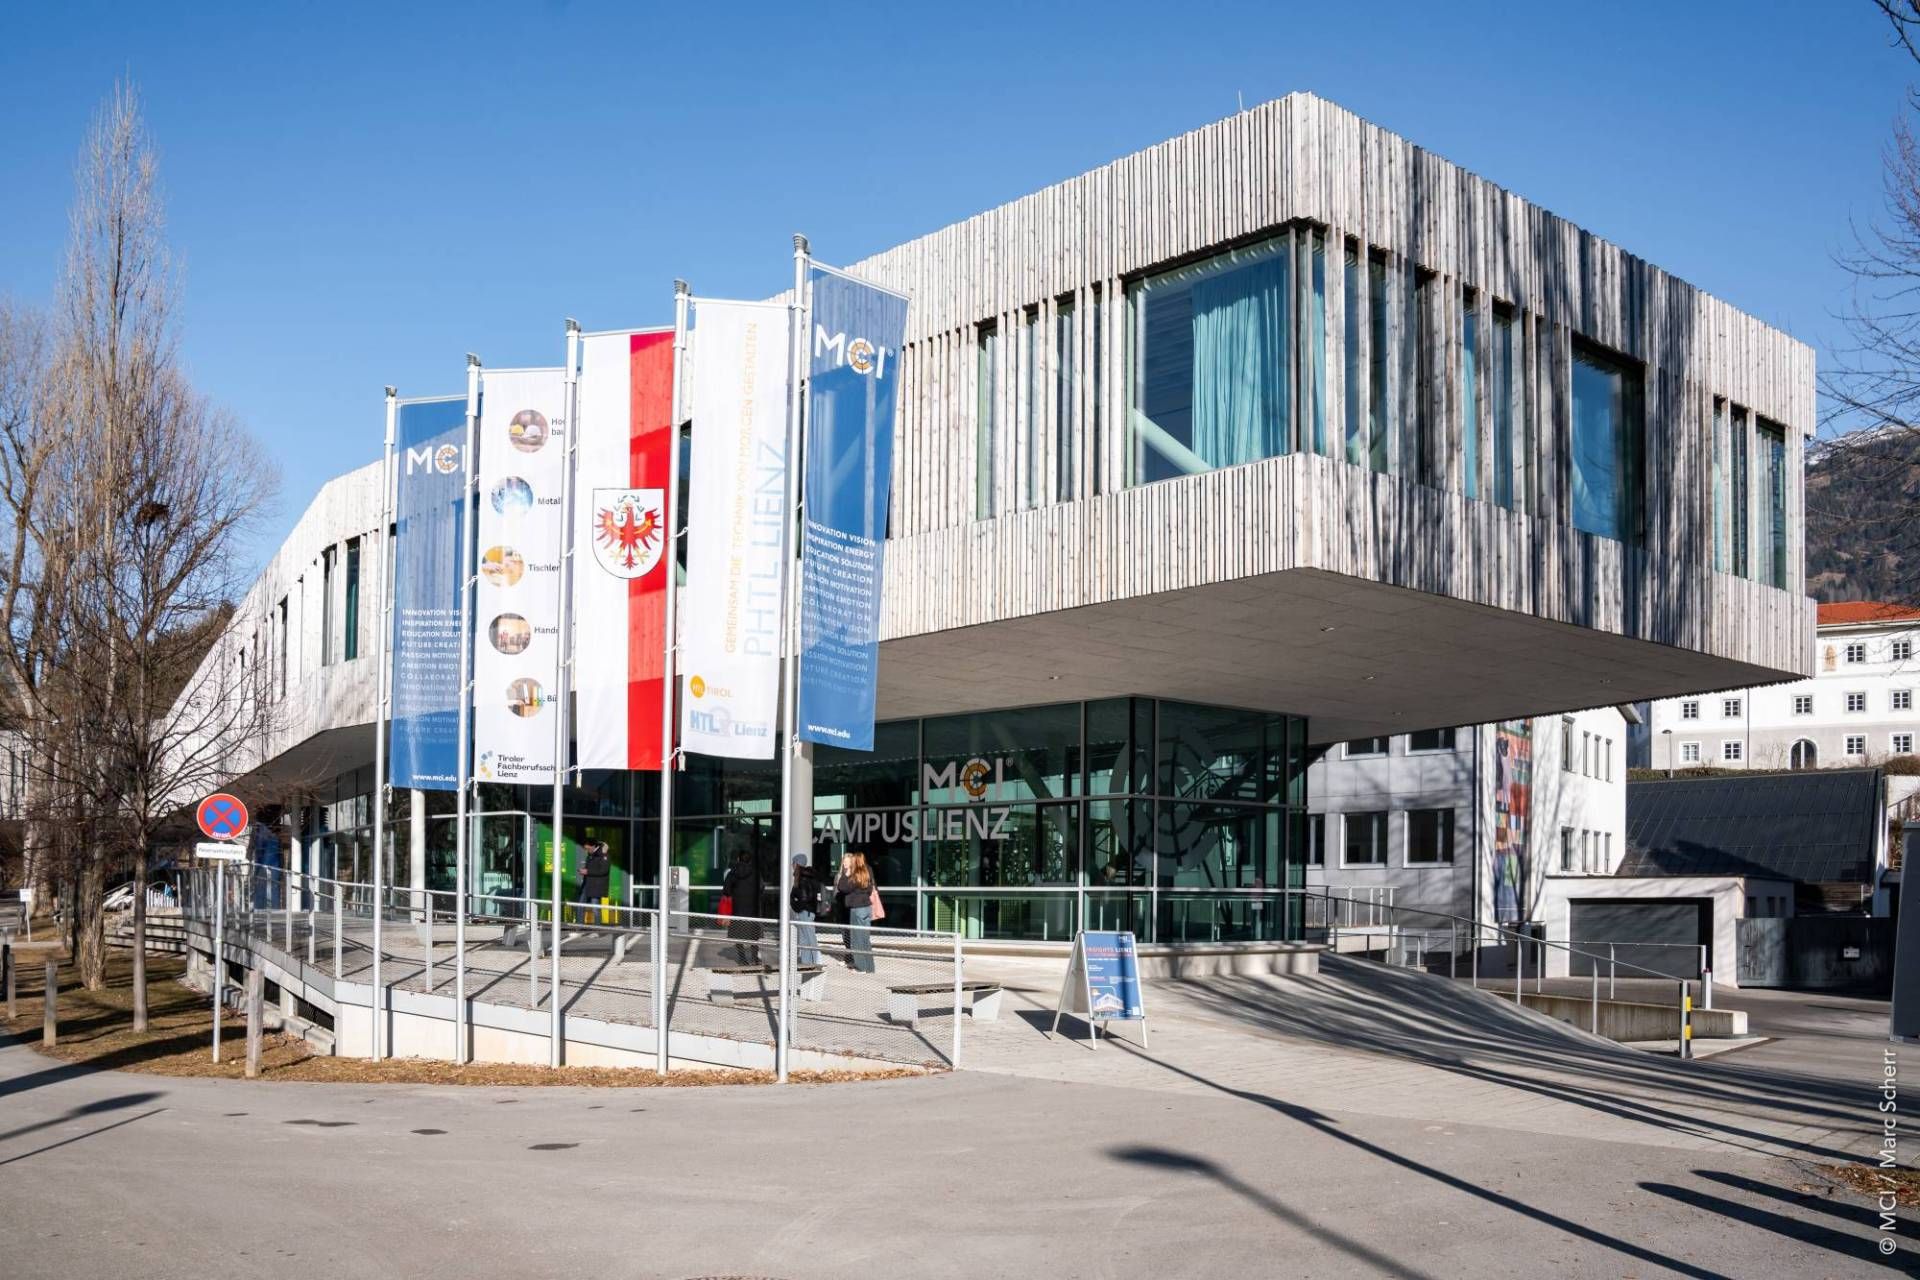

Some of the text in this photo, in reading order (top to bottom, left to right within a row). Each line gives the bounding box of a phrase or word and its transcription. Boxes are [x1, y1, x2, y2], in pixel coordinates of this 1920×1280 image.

[743, 322, 758, 395] GESTALTEN
[738, 399, 752, 457] MORGEN
[537, 496, 561, 505] Metal
[807, 520, 875, 547] INNOVATION VISION
[845, 546, 875, 559] ENERGY
[730, 556, 742, 576] DIE
[841, 559, 873, 571] SOLUTION
[832, 568, 873, 585] CREATION
[830, 580, 872, 597] MOTIVATION
[402, 608, 446, 616] INNOVATION
[724, 580, 738, 653] GEMEINSAM
[707, 686, 735, 698] TIROL
[690, 709, 768, 737] HTL Lienz
[497, 754, 525, 762] Tiroler
[497, 763, 556, 772] Fachberufssch
[497, 770, 518, 778] Lienz
[412, 774, 457, 782] www.mci.edu
